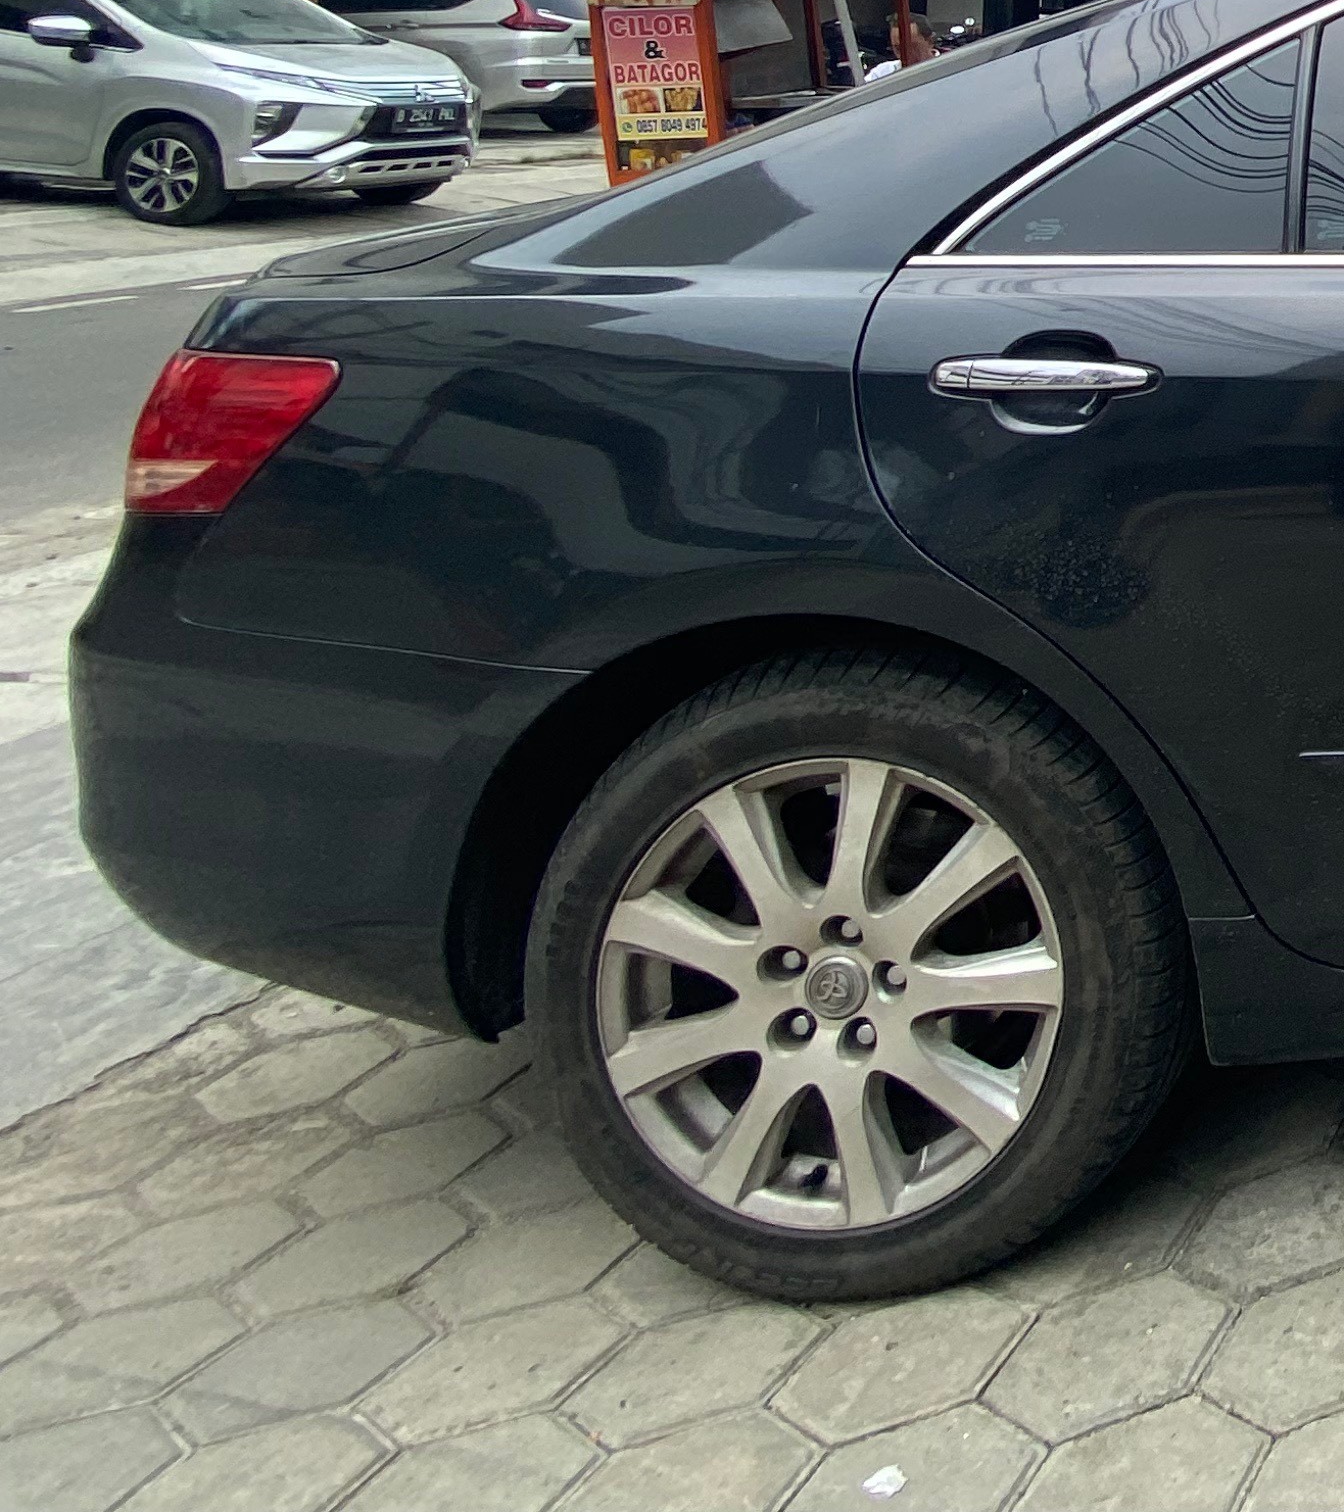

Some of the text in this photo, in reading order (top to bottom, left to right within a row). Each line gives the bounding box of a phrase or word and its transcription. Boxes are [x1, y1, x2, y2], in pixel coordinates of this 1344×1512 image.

[608, 16, 694, 37] CILOR
[644, 40, 666, 60] &
[614, 62, 701, 84] BATAGOR
